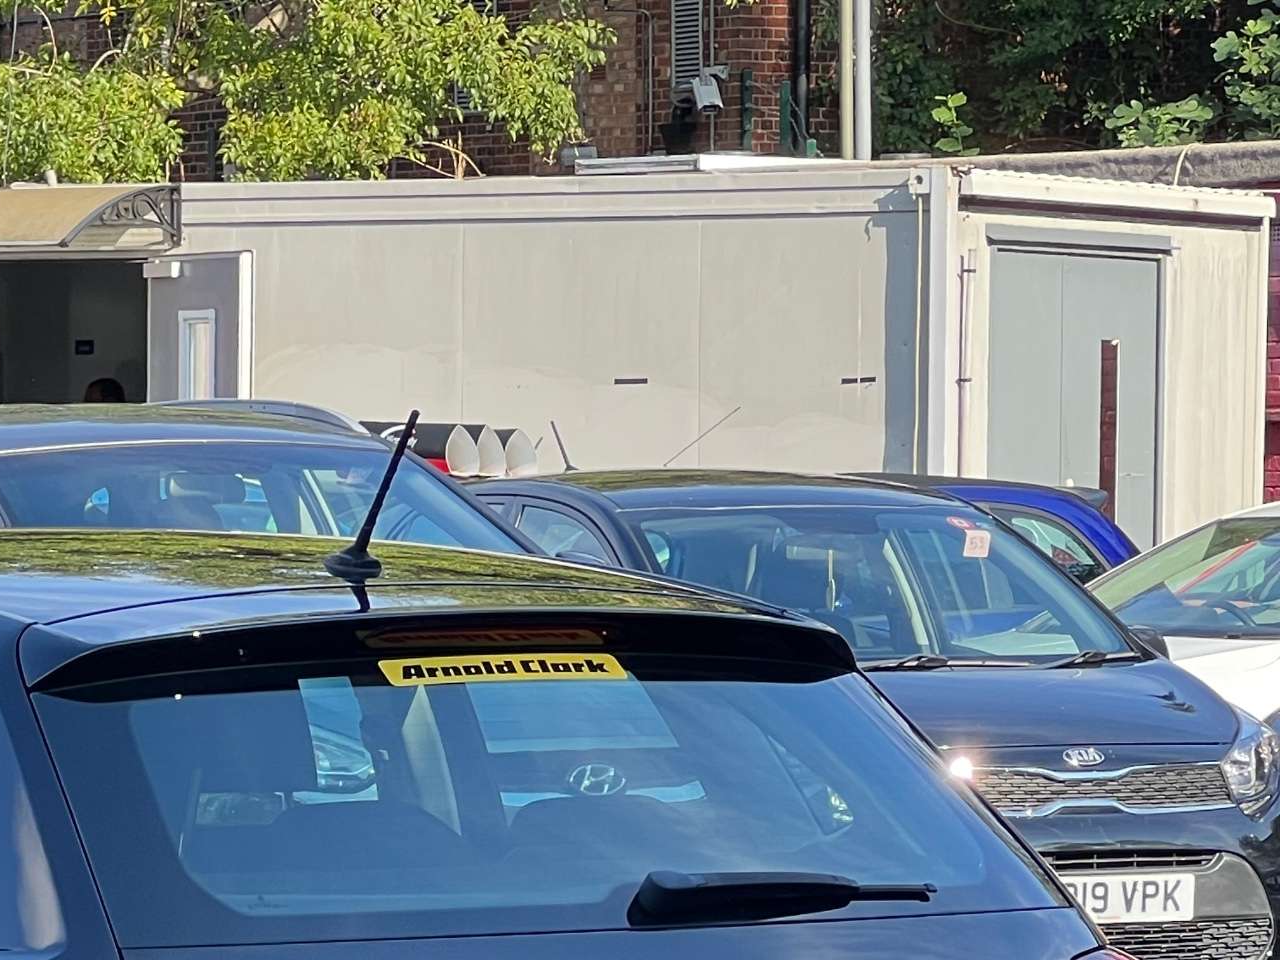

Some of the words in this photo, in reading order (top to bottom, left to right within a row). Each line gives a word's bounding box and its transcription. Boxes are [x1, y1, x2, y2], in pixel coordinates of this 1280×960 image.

[402, 660, 516, 679] Arnold
[521, 659, 610, 674] Clark
[1067, 748, 1101, 765] KIA
[1121, 879, 1182, 913] VPK
